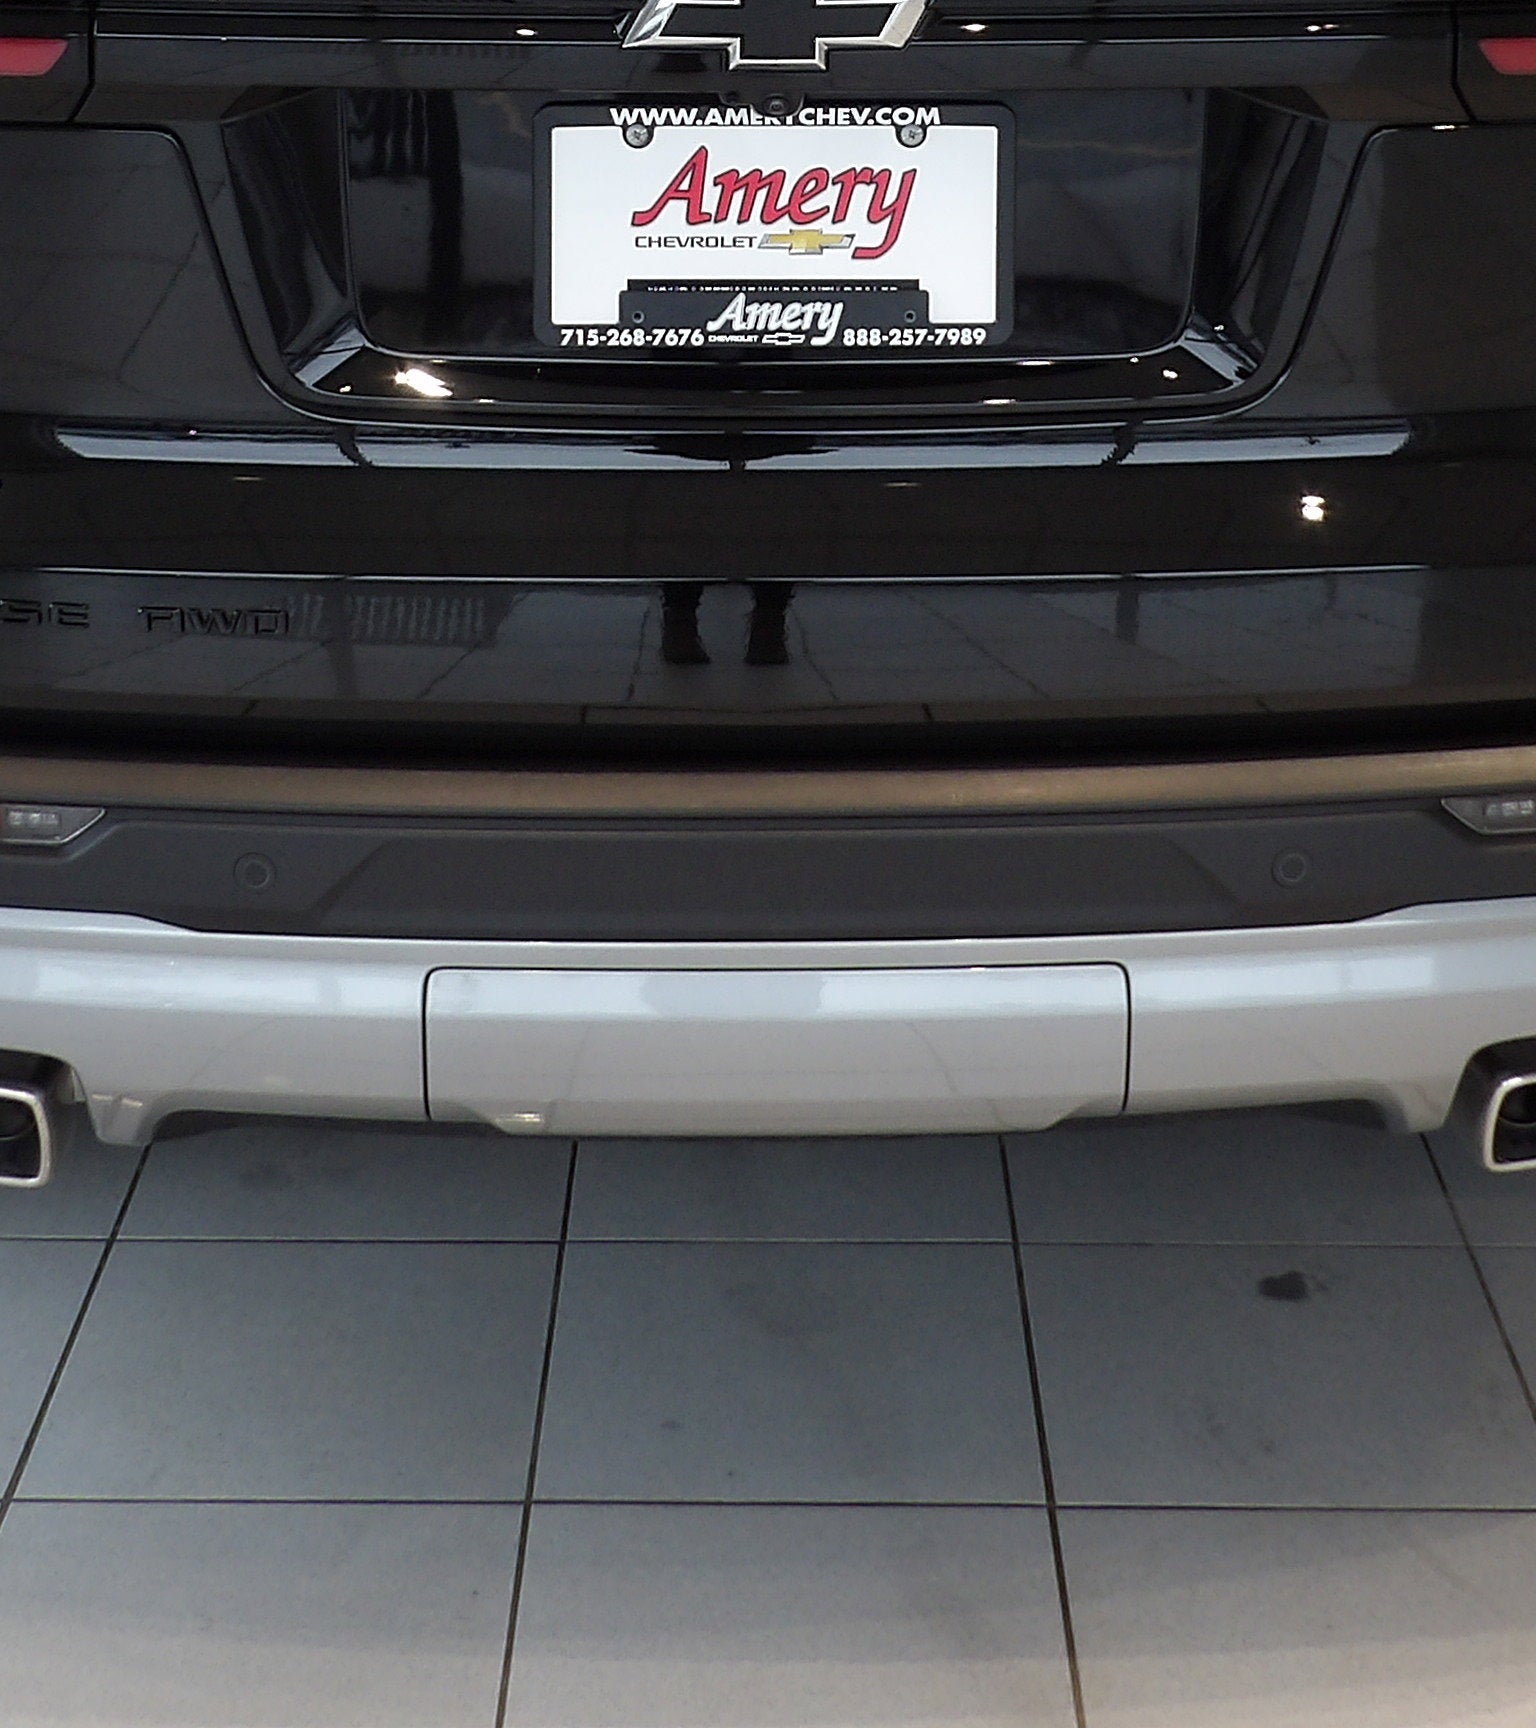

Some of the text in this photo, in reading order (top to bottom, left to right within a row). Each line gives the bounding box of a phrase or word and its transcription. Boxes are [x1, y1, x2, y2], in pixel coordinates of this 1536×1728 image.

[631, 145, 917, 259] Amery
[635, 236, 757, 248] CHEVROLET
[706, 292, 844, 346] Amery
[561, 328, 704, 347] 715-268-7676
[843, 328, 986, 347] 888-257-7989
